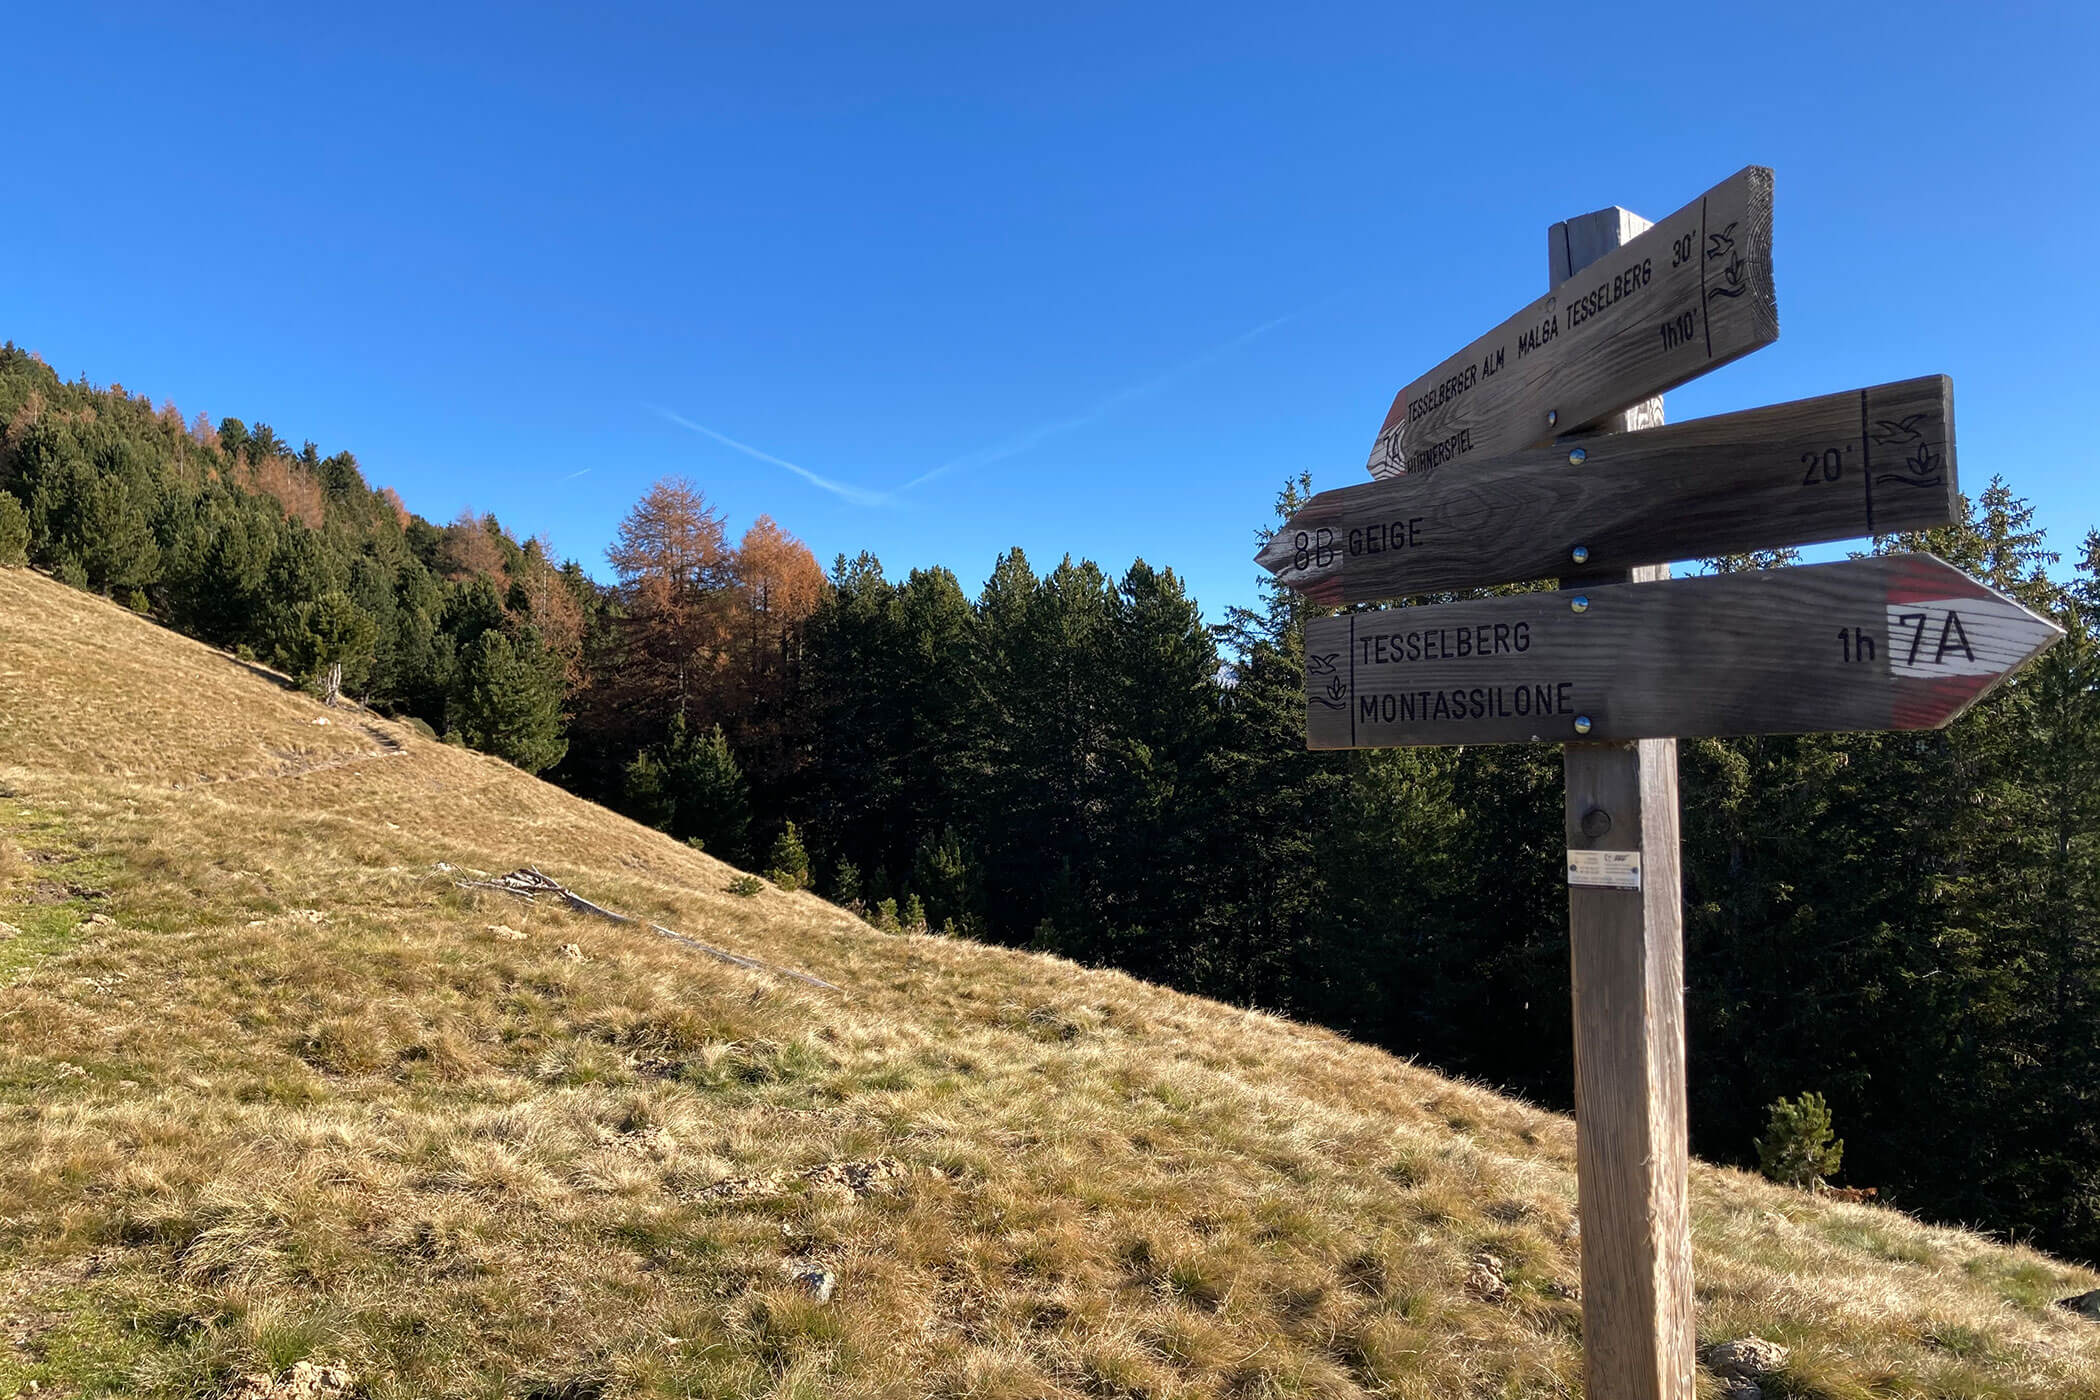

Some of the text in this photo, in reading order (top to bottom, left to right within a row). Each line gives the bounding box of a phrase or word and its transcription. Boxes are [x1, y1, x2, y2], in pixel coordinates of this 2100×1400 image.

[1408, 229, 1697, 424] TESSELBERGER ALM MALGA TESSELBERG 30'
[1801, 445, 1853, 486] 20'
[1294, 527, 1334, 571] 8B
[1349, 517, 1424, 557] GEIGE
[1360, 621, 1531, 665] TESSELBERG
[1837, 626, 1875, 663] 1h
[1899, 610, 1975, 666] 7A
[1360, 682, 1575, 724] MONTASSILONE
